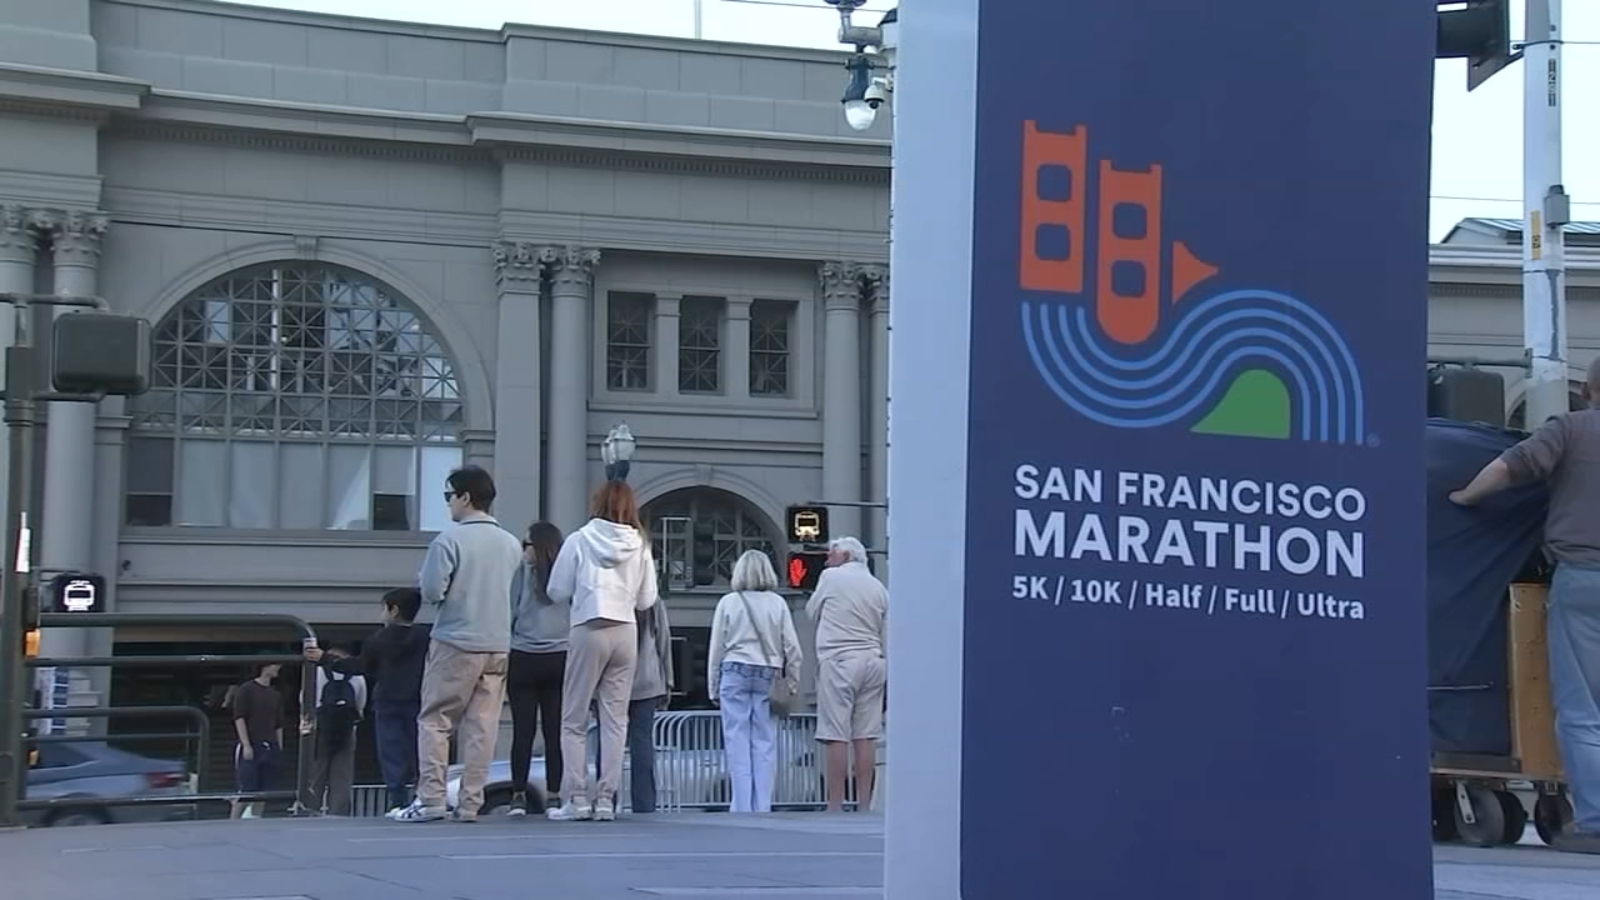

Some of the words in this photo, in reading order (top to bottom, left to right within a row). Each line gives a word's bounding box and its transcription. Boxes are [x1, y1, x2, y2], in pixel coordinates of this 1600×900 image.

[1014, 464, 1102, 503] SAN
[1118, 471, 1366, 521] FRANCISCO
[1014, 509, 1364, 578] MARATHON
[1012, 575, 1049, 600] 5K
[1071, 579, 1122, 604] 10K
[1145, 583, 1203, 609] Half
[1225, 588, 1275, 614] Full
[1297, 592, 1364, 619] Ultra
